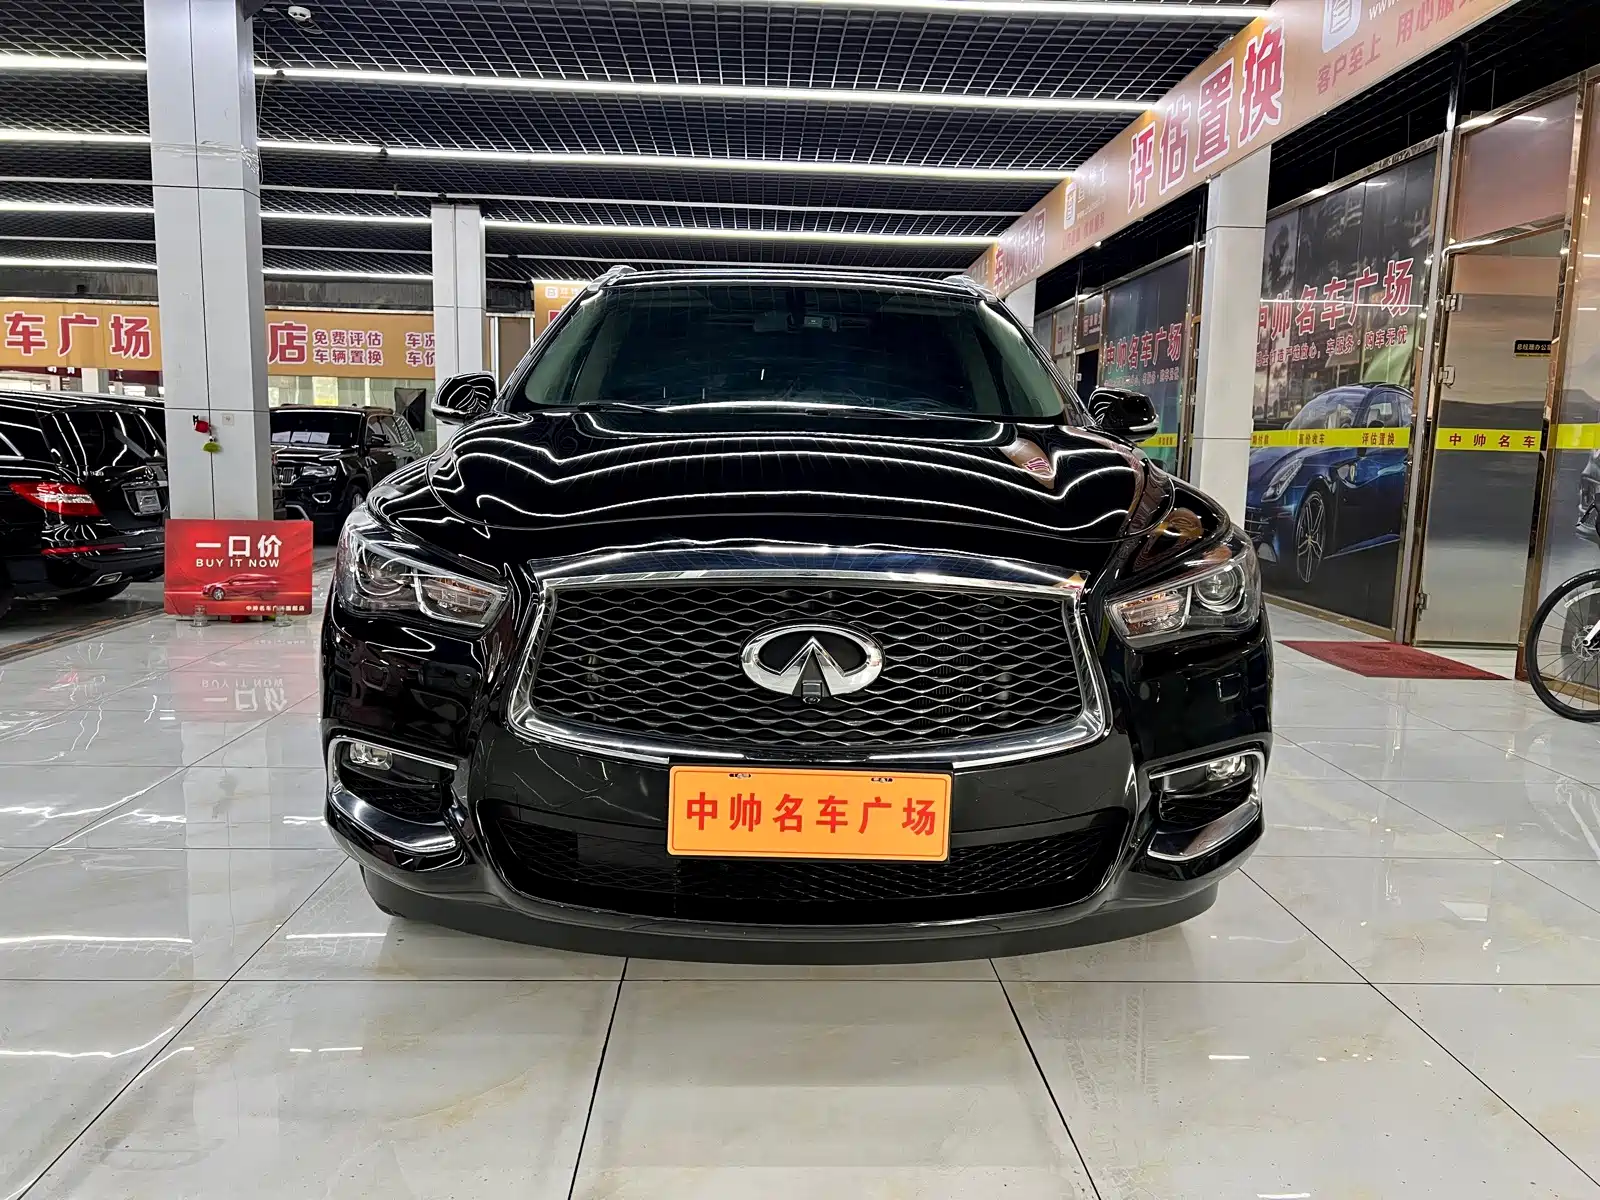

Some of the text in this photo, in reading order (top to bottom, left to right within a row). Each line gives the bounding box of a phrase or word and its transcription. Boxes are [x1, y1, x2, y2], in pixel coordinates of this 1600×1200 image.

[1317, 34, 1381, 95] 客户至上
[1128, 22, 1285, 215] 评估置换
[4, 311, 152, 359] 车广场
[268, 321, 308, 364] 店
[312, 329, 383, 347] 免费评估
[1104, 322, 1183, 375] 中帅名车广场
[313, 348, 384, 365] 车辆置换
[1362, 432, 1395, 446] 评估置换
[1449, 433, 1536, 448] 中帅名车
[195, 534, 283, 558] 一口价
[195, 558, 280, 568] BUY IT NOW
[686, 791, 936, 836] 中帅名车广场
